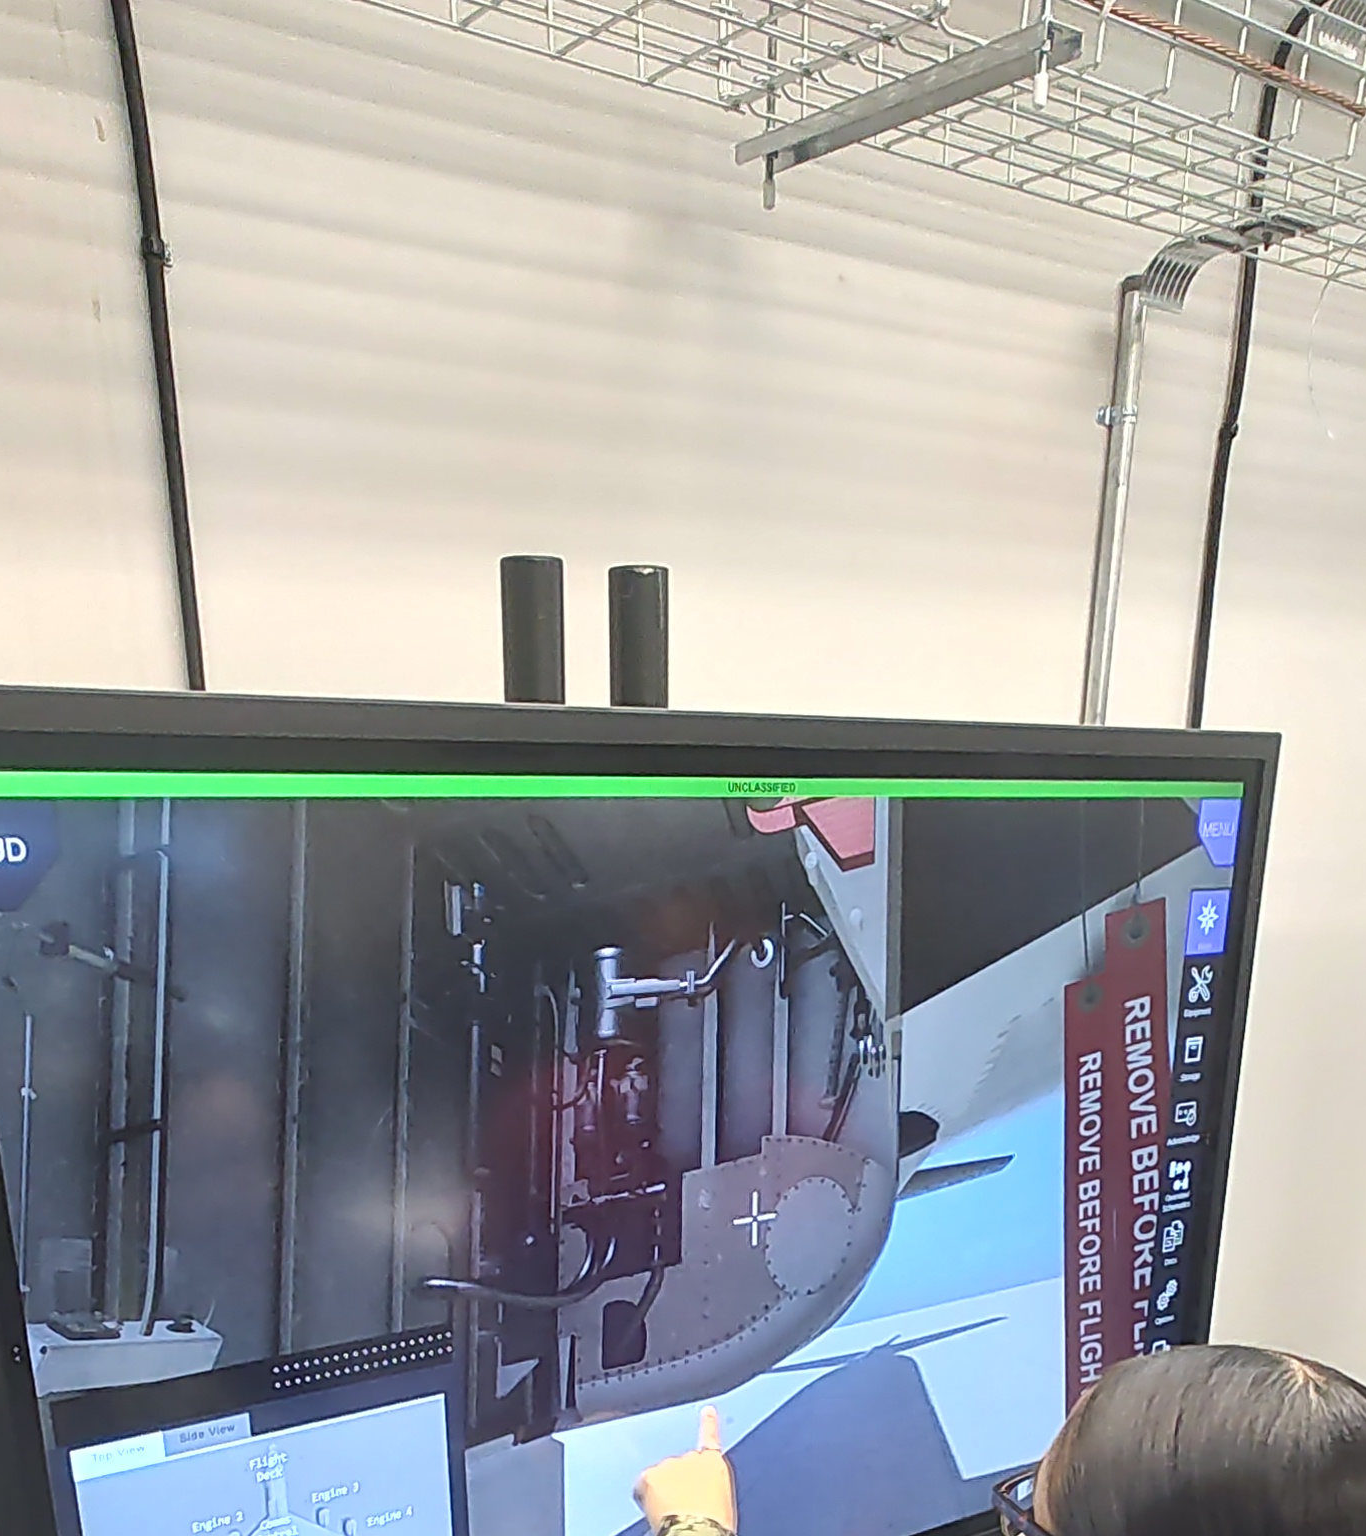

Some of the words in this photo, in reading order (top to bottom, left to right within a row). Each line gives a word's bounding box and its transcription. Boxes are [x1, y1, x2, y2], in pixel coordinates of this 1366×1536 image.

[727, 782, 796, 793] UNCLASSIFIED
[1202, 822, 1235, 838] MENU
[1123, 993, 1158, 1140] REMOVE
[1078, 1050, 1103, 1175] REMOVE
[1130, 1144, 1160, 1291] BEFORE
[1078, 1178, 1103, 1296] BEFORE
[1079, 1299, 1103, 1397] FLIGH
[179, 1430, 205, 1444] Side
[207, 1423, 236, 1437] View
[90, 1452, 113, 1464] Top
[116, 1445, 146, 1458] View
[248, 1451, 289, 1472] Flight
[256, 1465, 284, 1483] Deck
[311, 1485, 349, 1504] Engine
[352, 1481, 361, 1494] 3
[191, 1513, 232, 1534] Engine
[235, 1510, 245, 1523] 2
[366, 1508, 403, 1528] Engine
[404, 1505, 414, 1518] 4
